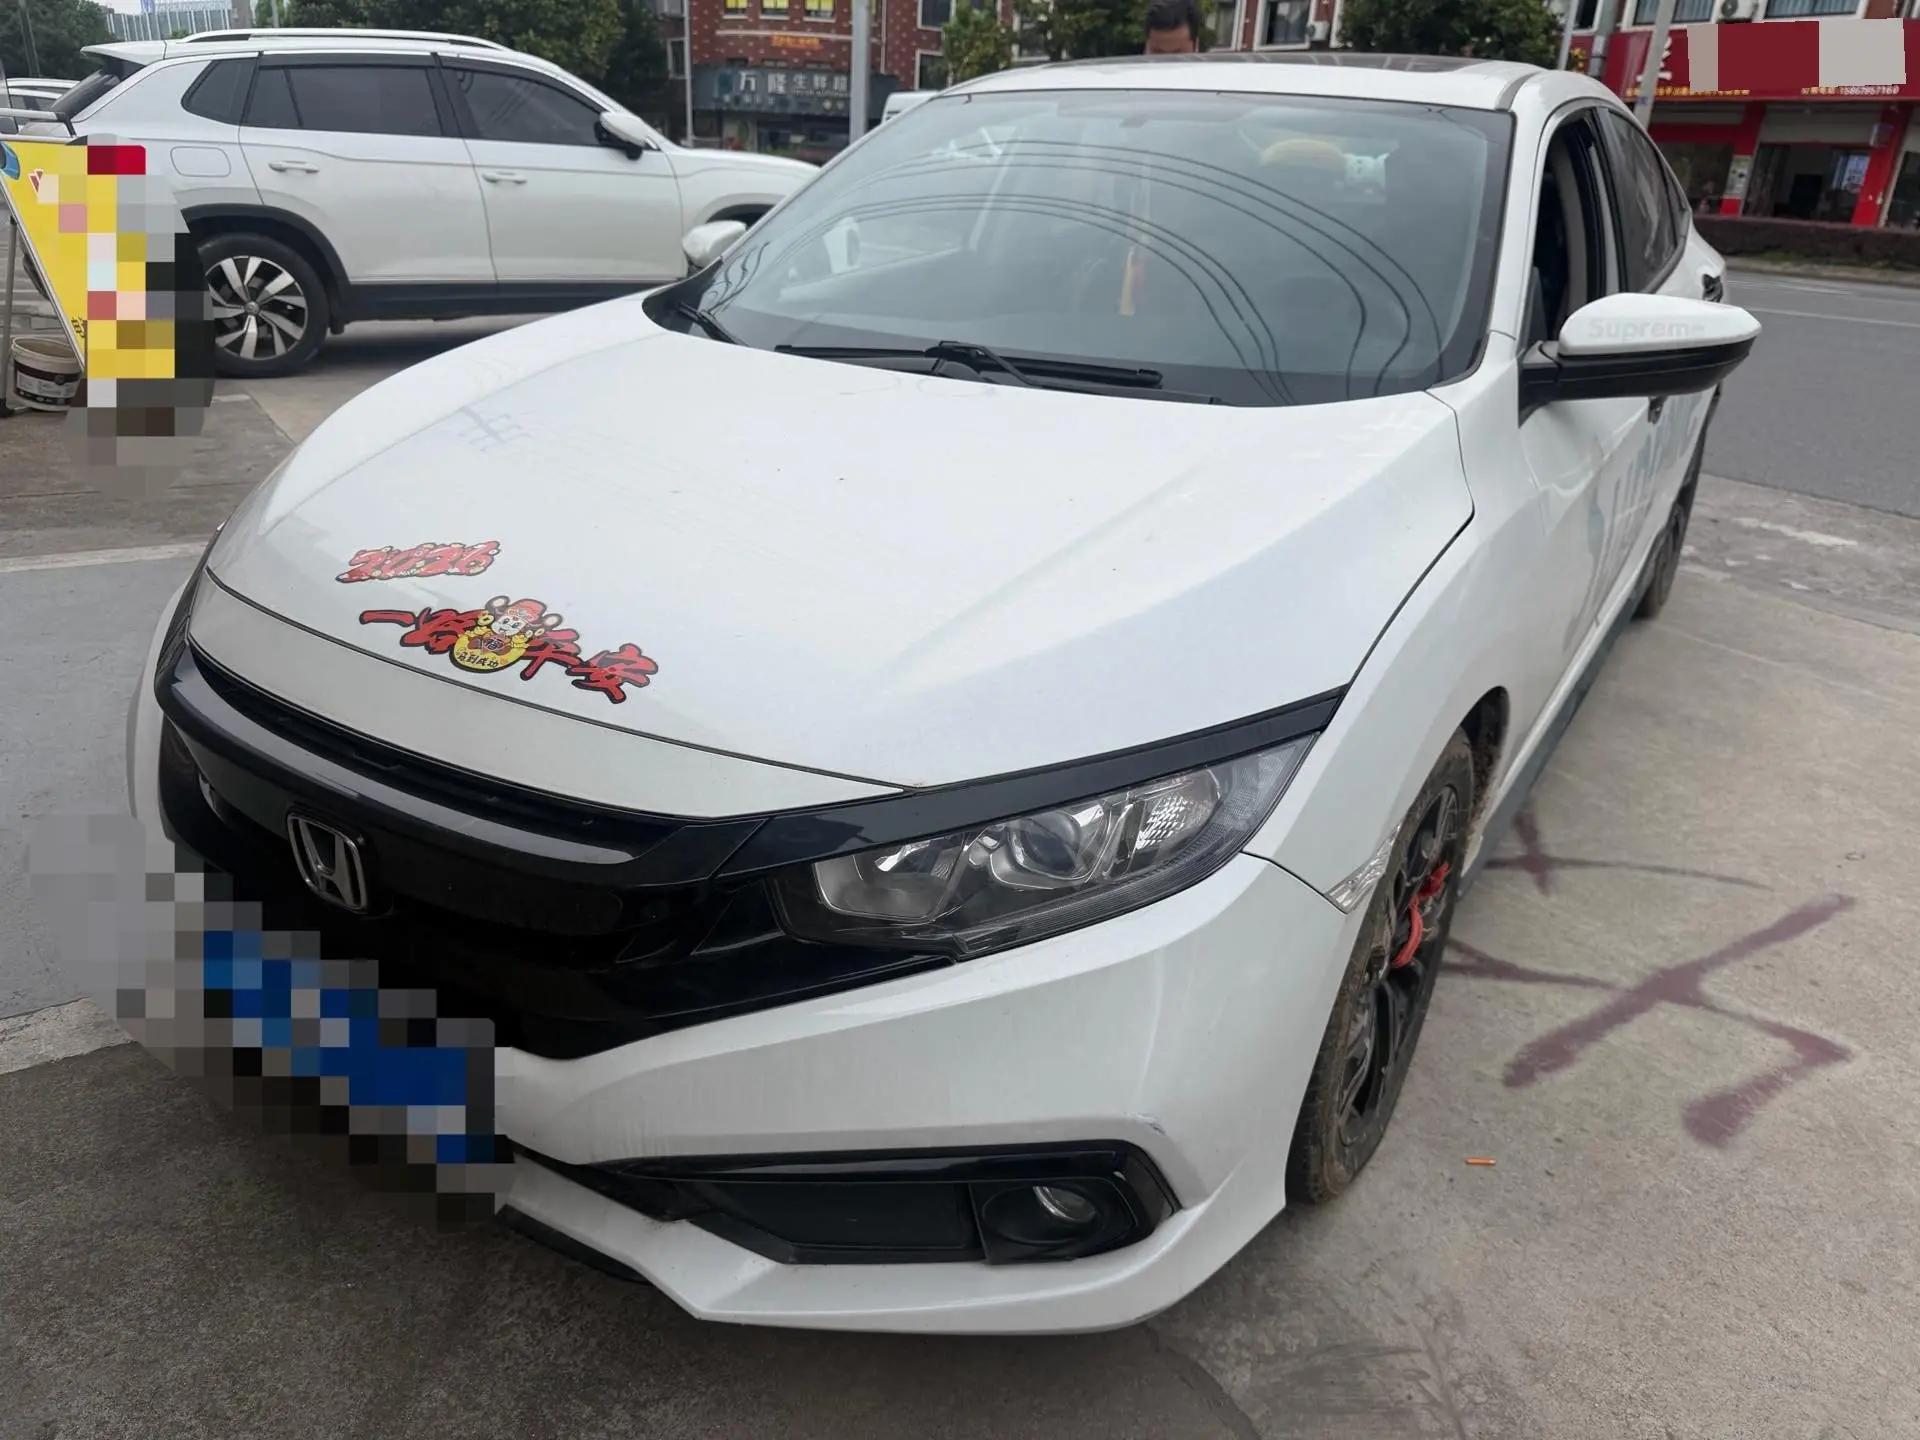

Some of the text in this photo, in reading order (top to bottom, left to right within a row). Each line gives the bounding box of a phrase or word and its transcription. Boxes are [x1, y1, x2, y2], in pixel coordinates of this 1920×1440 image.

[739, 71, 848, 95] 万隆生鲜超
